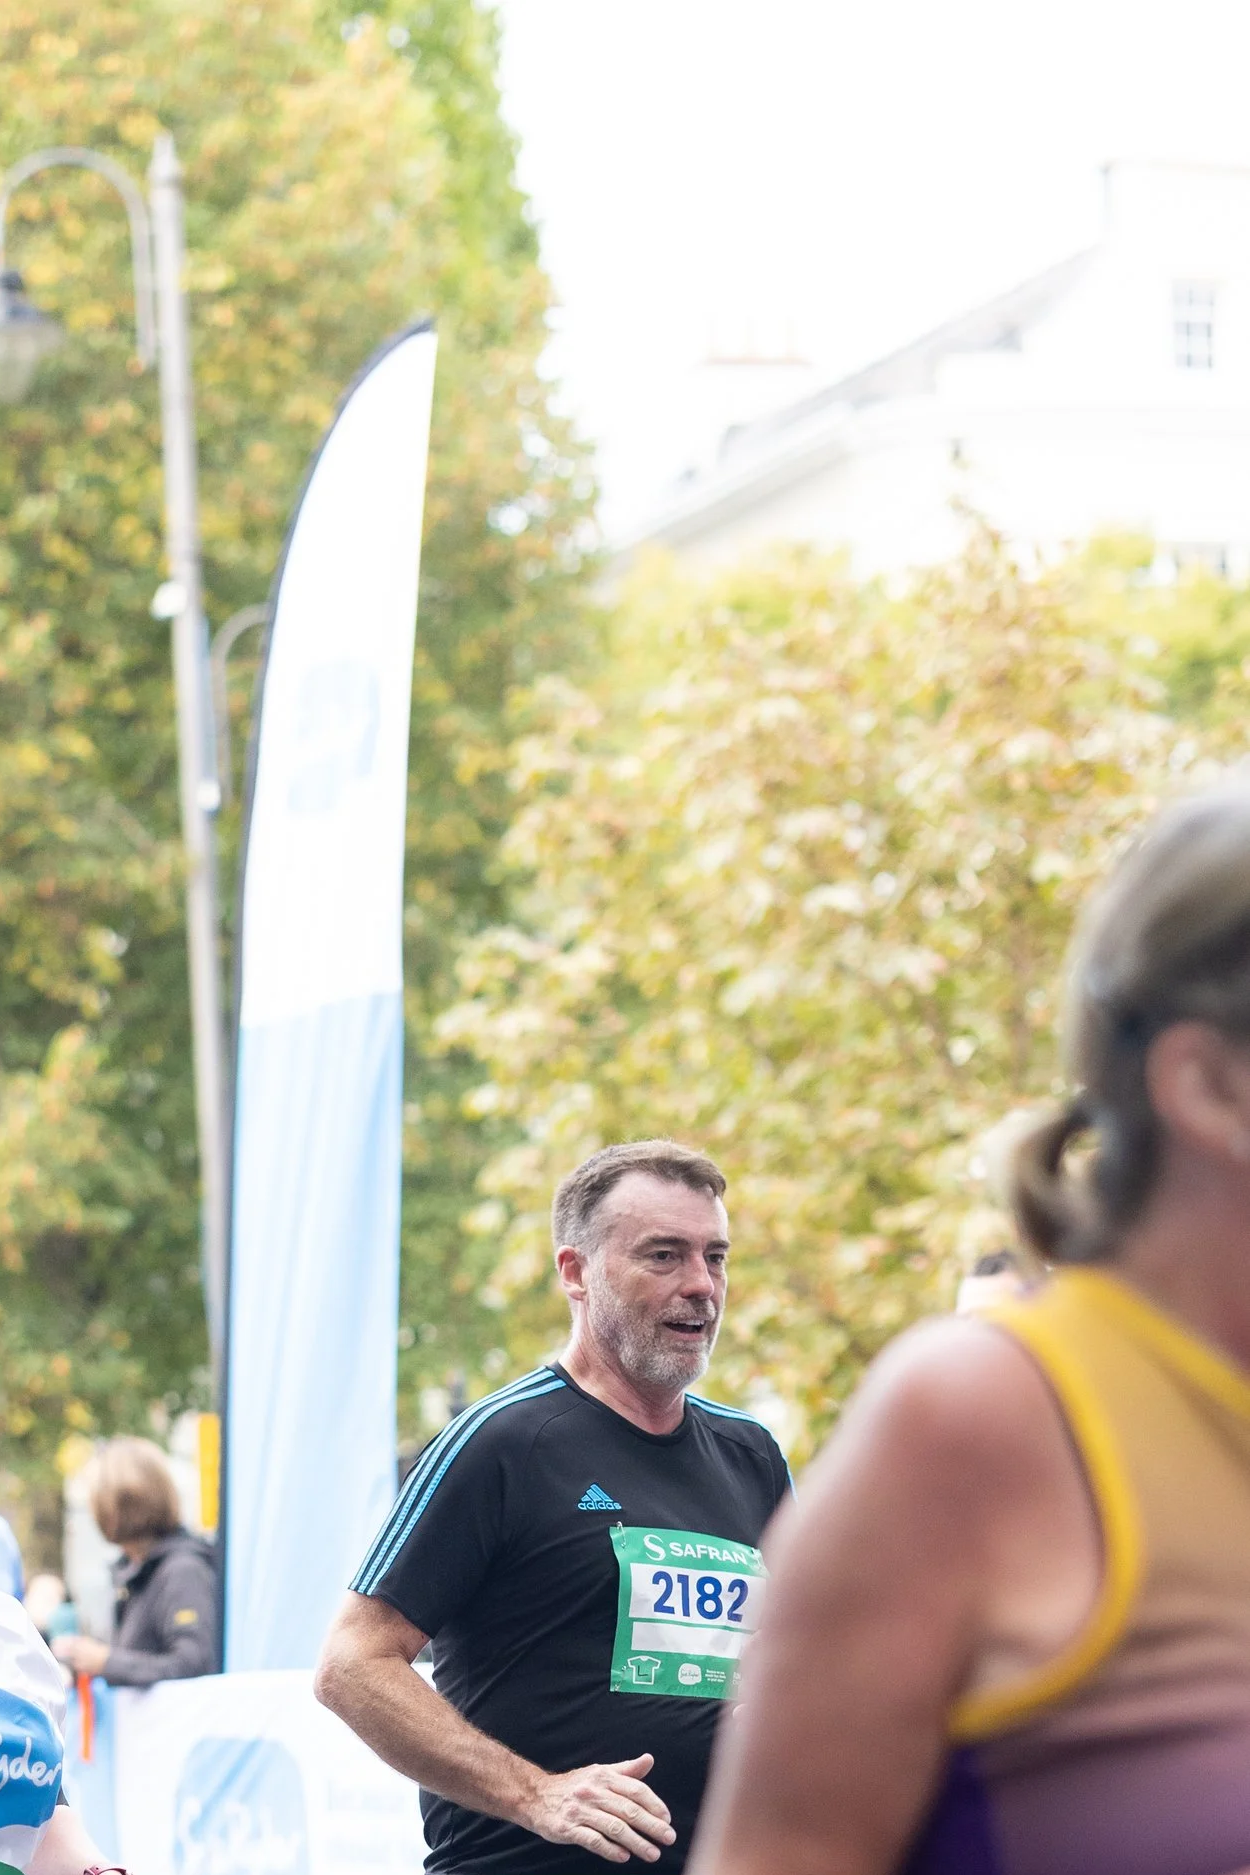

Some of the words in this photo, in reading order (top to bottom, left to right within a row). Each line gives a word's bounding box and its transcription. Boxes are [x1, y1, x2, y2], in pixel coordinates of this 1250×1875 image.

[577, 1500, 622, 1511] adidas
[669, 1542, 748, 1565] SAFRAN
[651, 1570, 749, 1623] 2182
